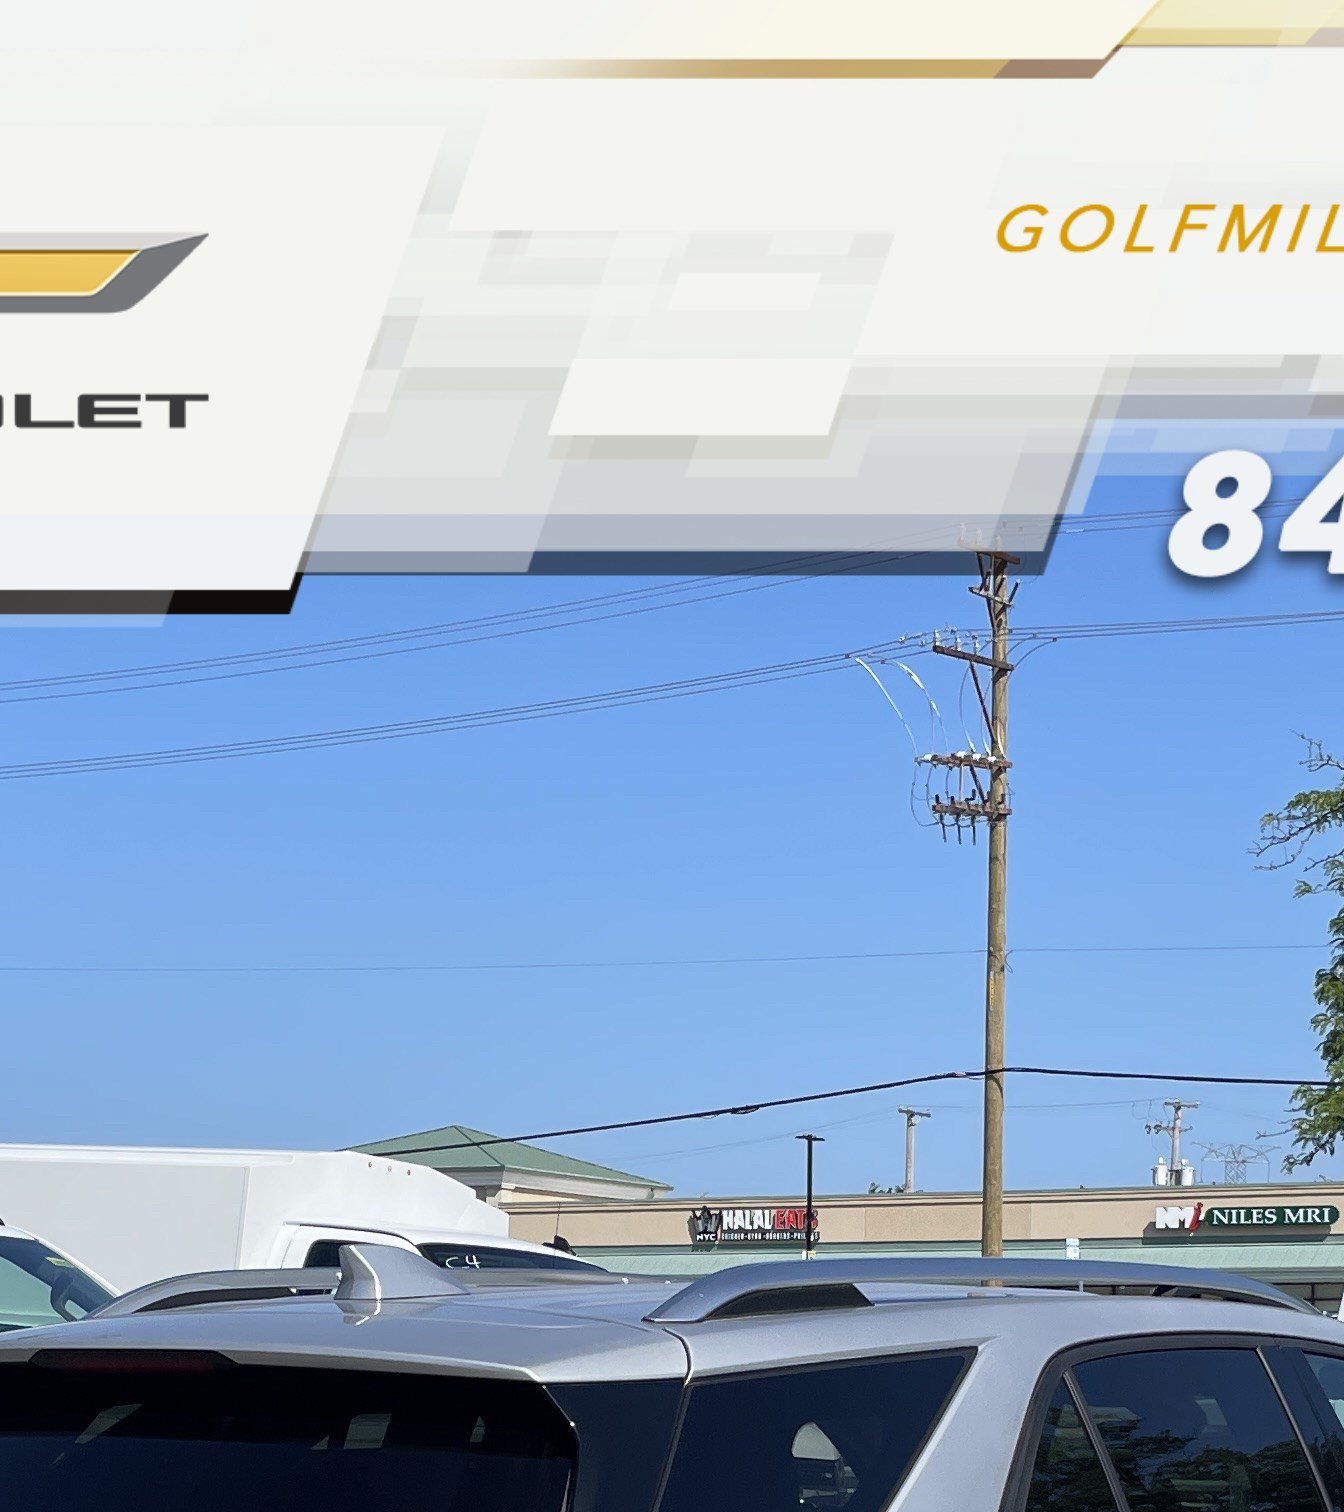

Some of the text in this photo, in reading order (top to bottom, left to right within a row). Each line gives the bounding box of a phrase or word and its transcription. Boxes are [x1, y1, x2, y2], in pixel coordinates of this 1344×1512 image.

[722, 1209, 773, 1230] HALAL
[1212, 1207, 1331, 1225] NILES MRI
[696, 1233, 717, 1241] NYC
